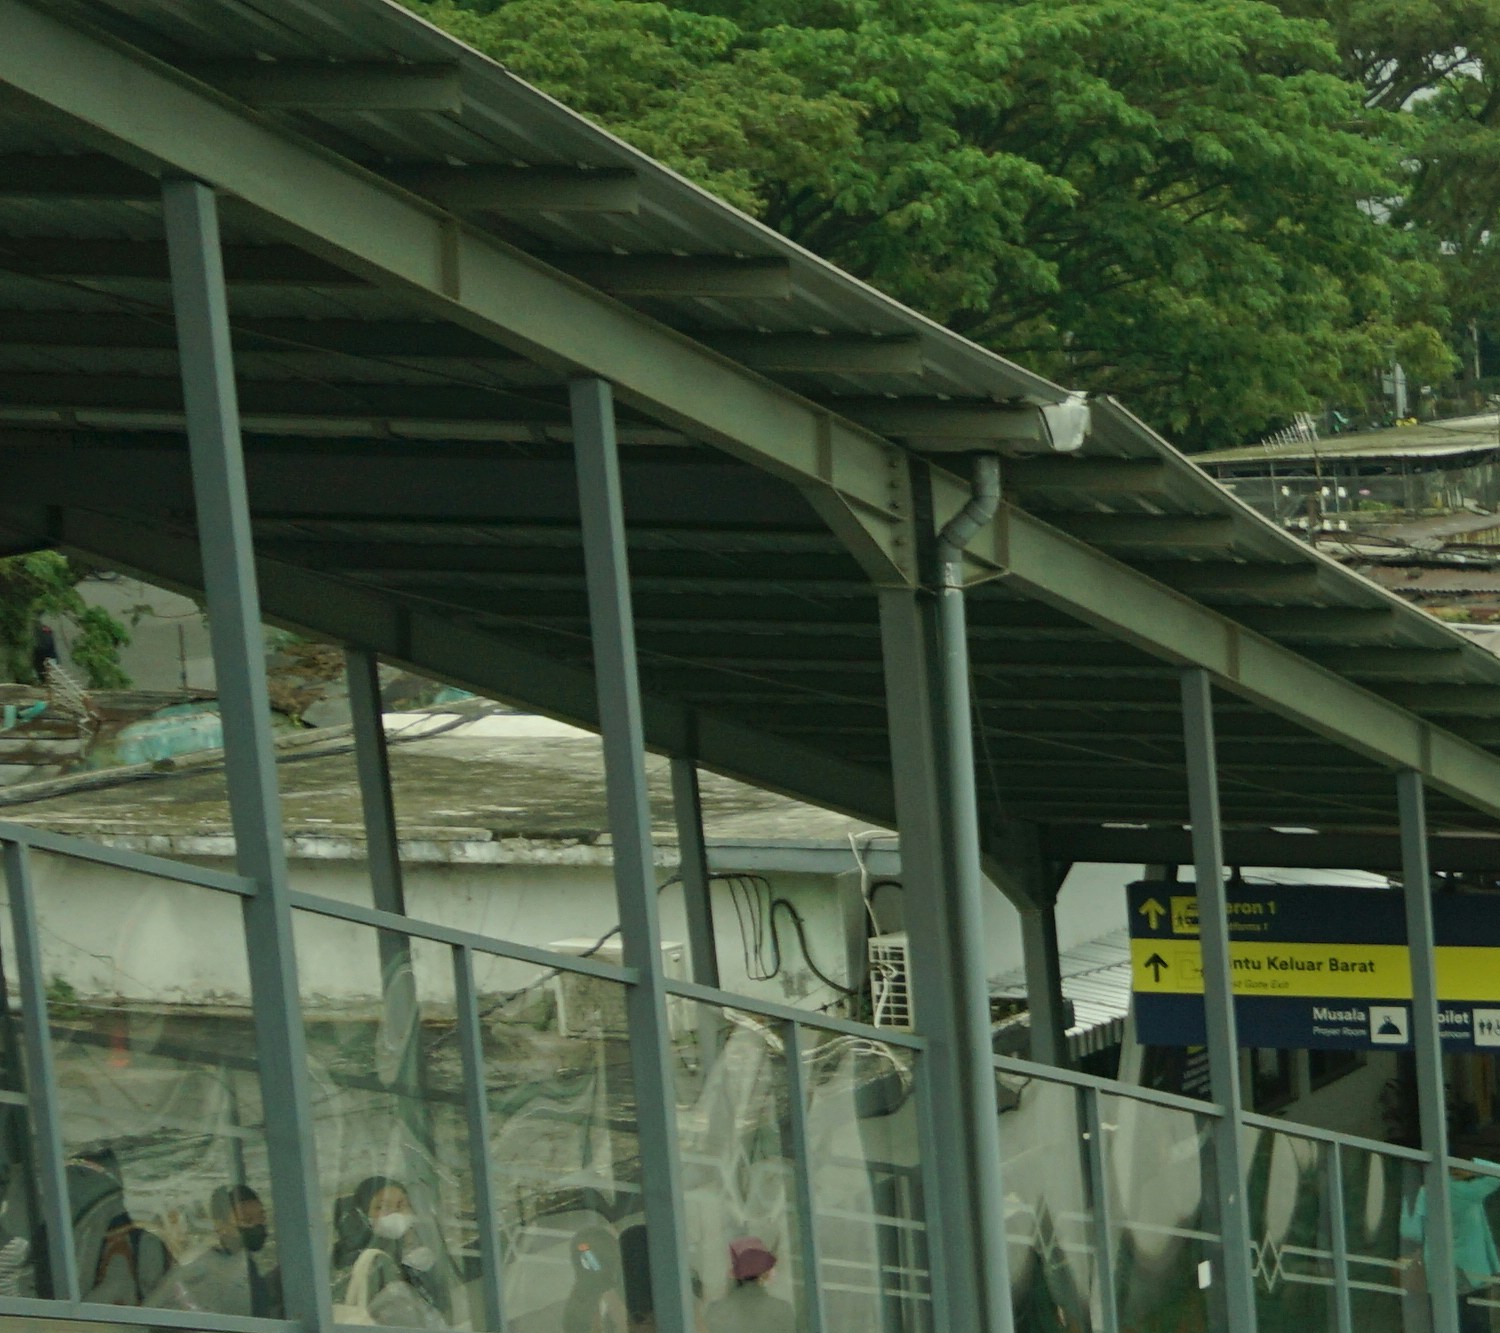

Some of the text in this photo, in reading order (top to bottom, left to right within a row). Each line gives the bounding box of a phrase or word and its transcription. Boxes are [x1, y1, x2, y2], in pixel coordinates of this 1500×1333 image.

[1226, 900, 1276, 915] eron 1
[1233, 956, 1376, 973] ntu Keluar Barat
[1312, 1006, 1470, 1025] Musala oilet
